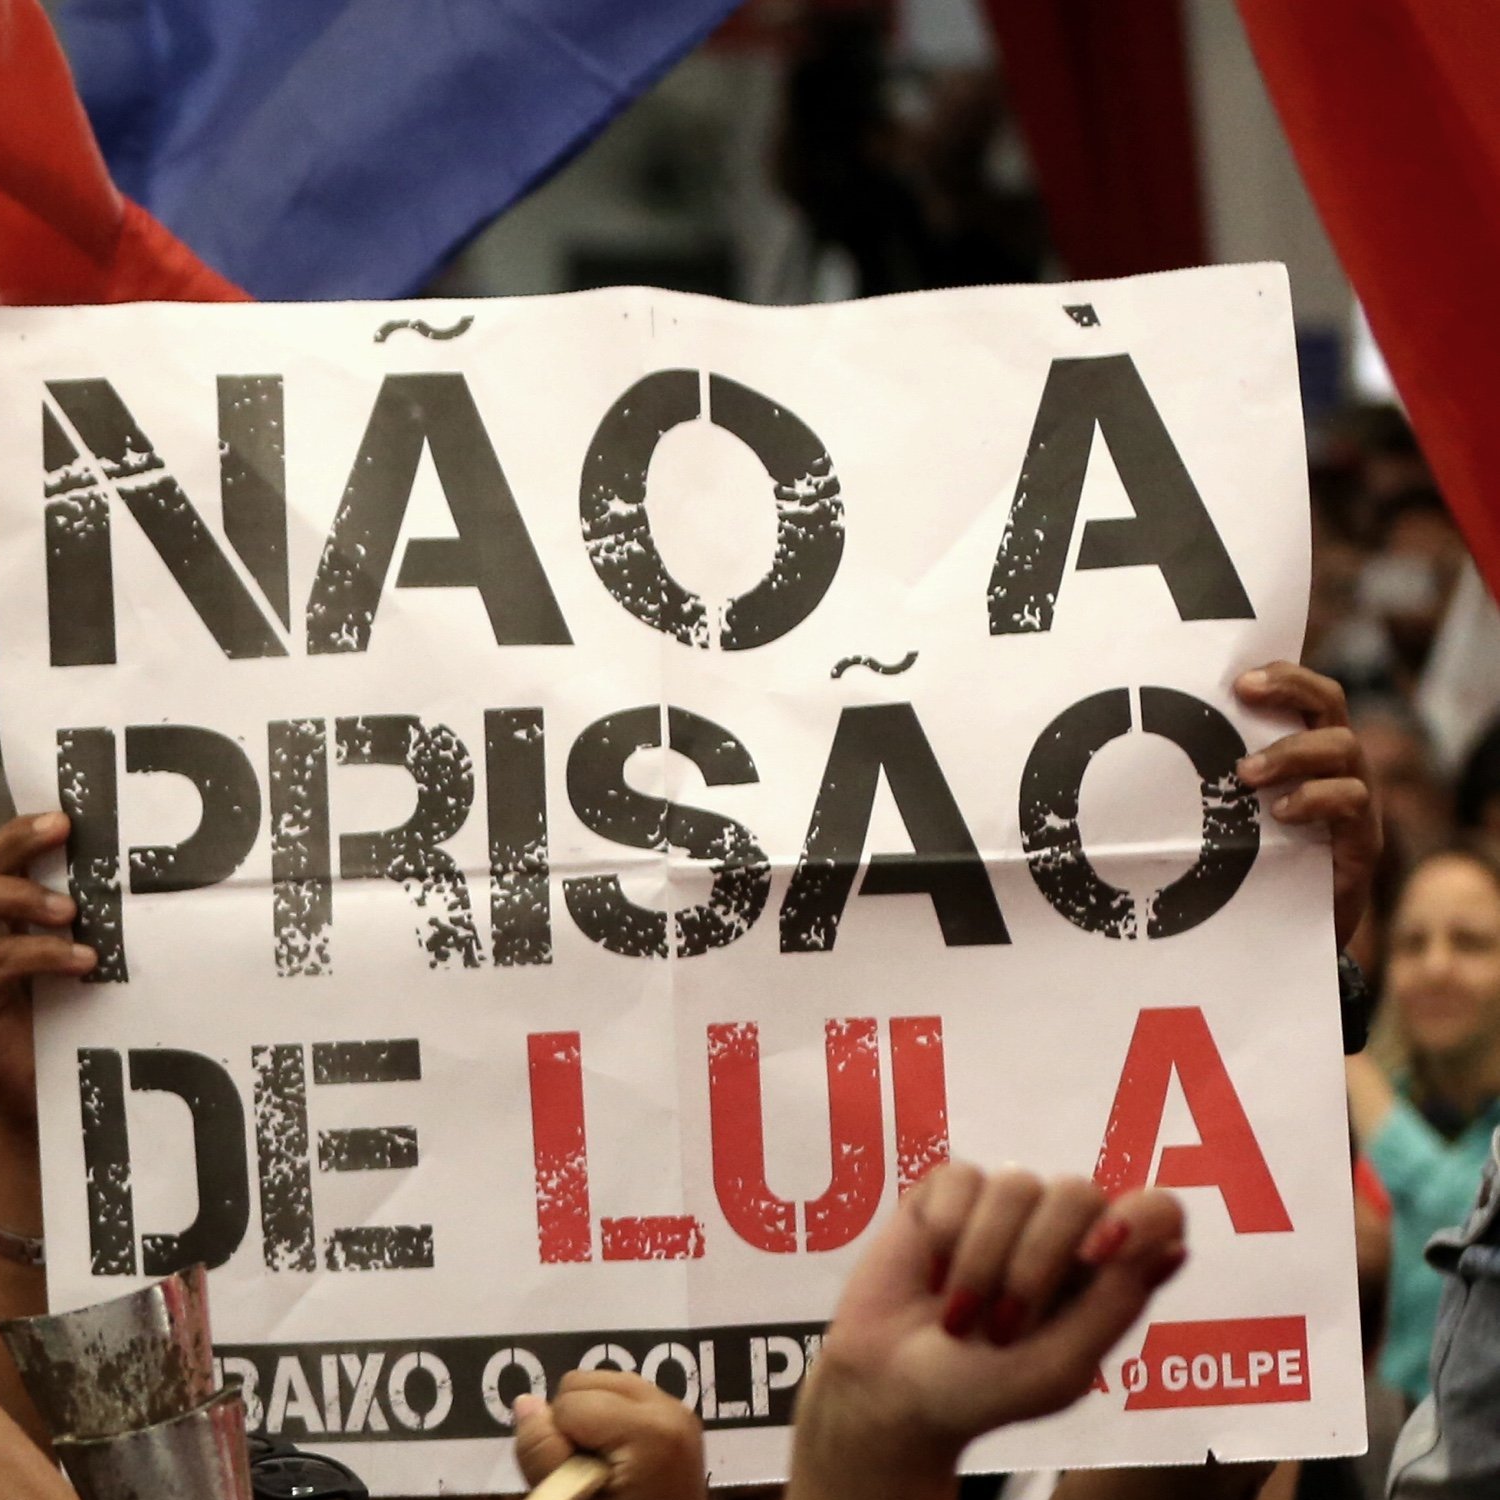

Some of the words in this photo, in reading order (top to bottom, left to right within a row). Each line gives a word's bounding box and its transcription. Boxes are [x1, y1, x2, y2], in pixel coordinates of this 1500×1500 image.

[41, 315, 846, 666] NÃO
[986, 304, 1256, 635] À
[56, 650, 1263, 984] PRISÃO
[76, 1037, 435, 1278] DE
[482, 1347, 547, 1427] O
[1161, 1349, 1303, 1393] GOLPE
